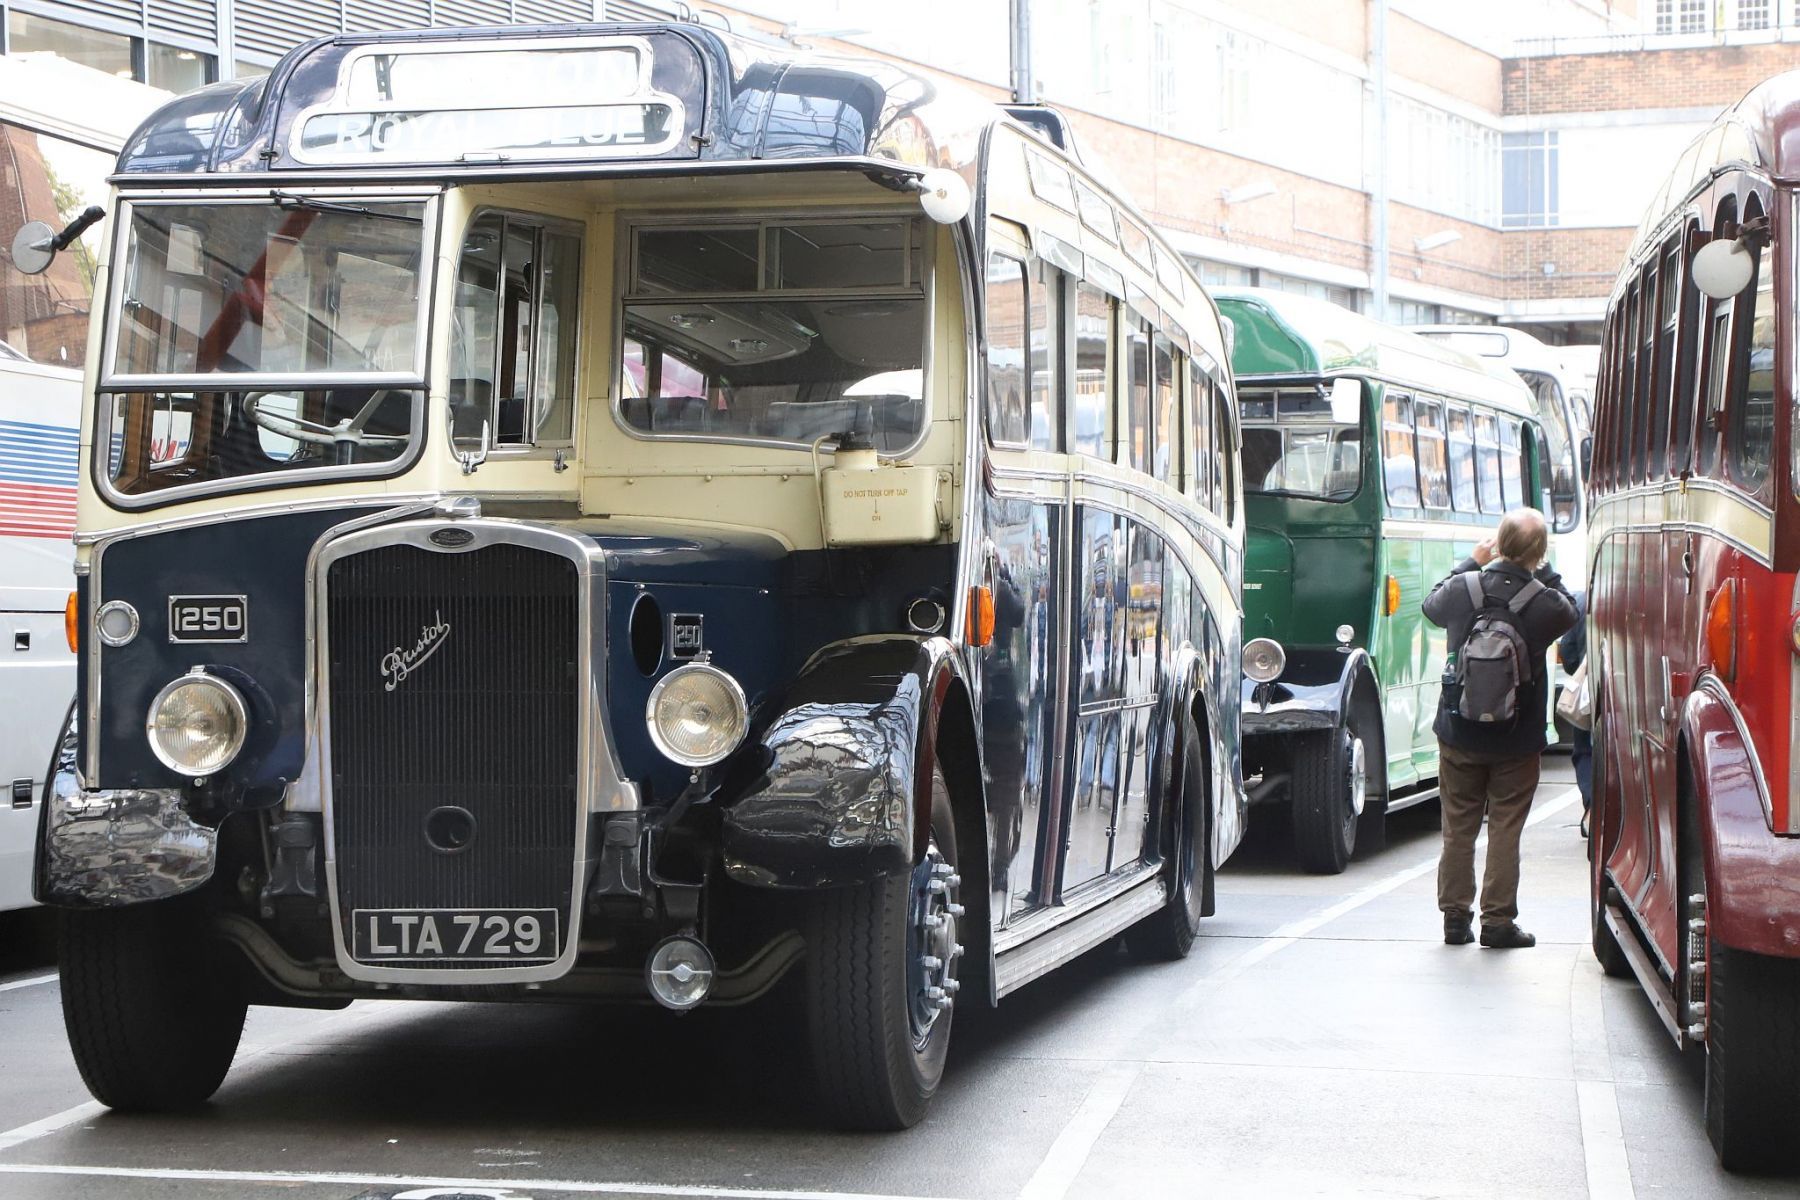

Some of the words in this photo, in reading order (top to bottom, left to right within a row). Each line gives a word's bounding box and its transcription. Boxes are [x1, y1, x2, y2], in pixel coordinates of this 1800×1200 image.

[518, 105, 646, 146] LUE
[843, 489, 854, 498] DO
[855, 489, 866, 498] NOT
[867, 488, 882, 498] TURN
[896, 487, 909, 497] TAP
[174, 606, 242, 631] 1250
[381, 609, 450, 691] Bristol
[674, 624, 700, 648] 1250
[370, 915, 444, 954] LTA
[453, 915, 541, 954] 729
